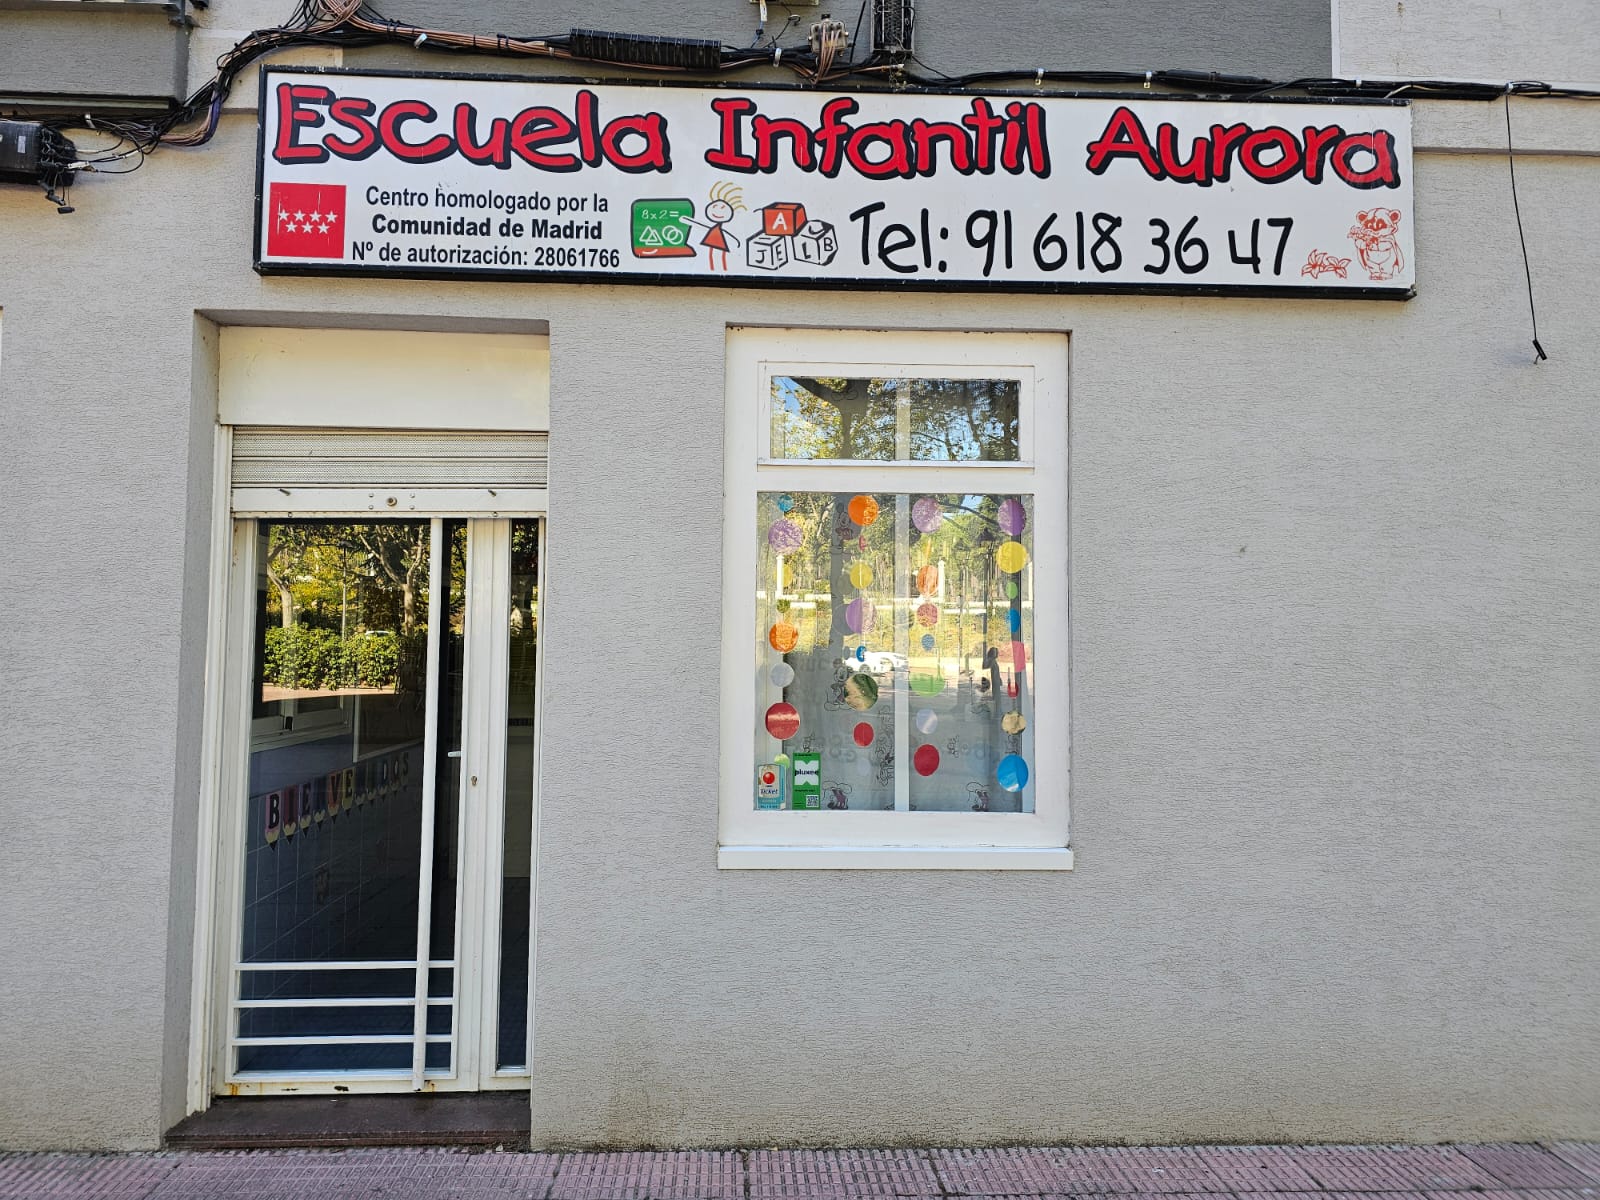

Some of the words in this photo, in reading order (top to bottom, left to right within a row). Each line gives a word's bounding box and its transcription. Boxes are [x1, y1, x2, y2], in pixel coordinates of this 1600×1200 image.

[273, 83, 672, 174] Escuela
[705, 95, 1052, 180] Infantil
[1086, 105, 1401, 190] Aurora
[366, 185, 429, 207] Centro
[435, 188, 551, 215] homologado
[556, 196, 588, 215] por
[593, 193, 608, 212] la
[372, 214, 491, 237] Comunidad
[499, 217, 524, 238] de
[531, 218, 602, 240] Madrid
[772, 212, 787, 231] A
[850, 201, 949, 273] Tel:
[965, 208, 1013, 276] 91
[1033, 211, 1122, 274] 618
[1143, 216, 1209, 275] 36
[1227, 217, 1294, 276] 47
[352, 241, 374, 261] Nº
[378, 242, 401, 262] de
[407, 245, 528, 266] autorización:
[534, 246, 620, 268] 28061766
